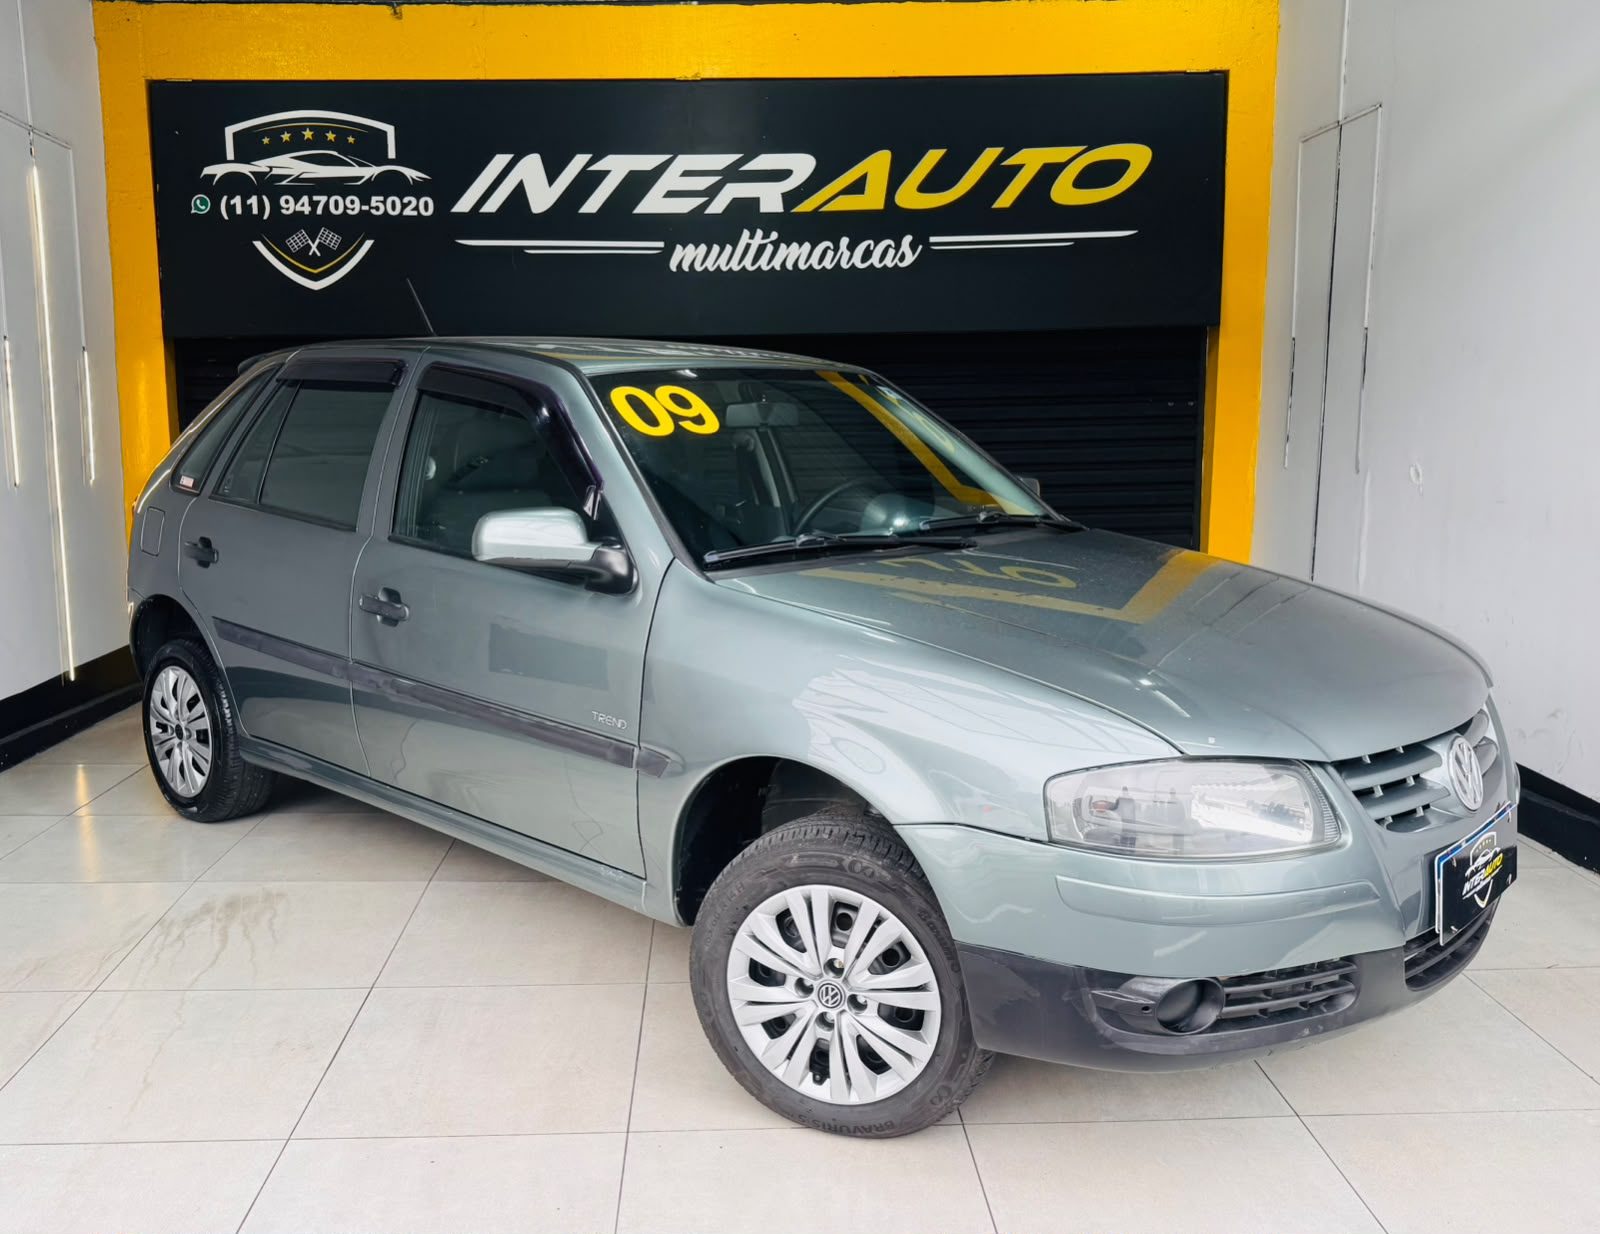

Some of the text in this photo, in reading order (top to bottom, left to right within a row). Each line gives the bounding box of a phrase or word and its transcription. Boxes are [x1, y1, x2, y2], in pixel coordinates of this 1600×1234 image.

[451, 143, 1153, 215] INTERAUTO
[220, 194, 434, 220] (11) 94709-5020
[668, 228, 922, 272] multimarcas
[610, 385, 720, 437] 09
[591, 710, 627, 729] TREND
